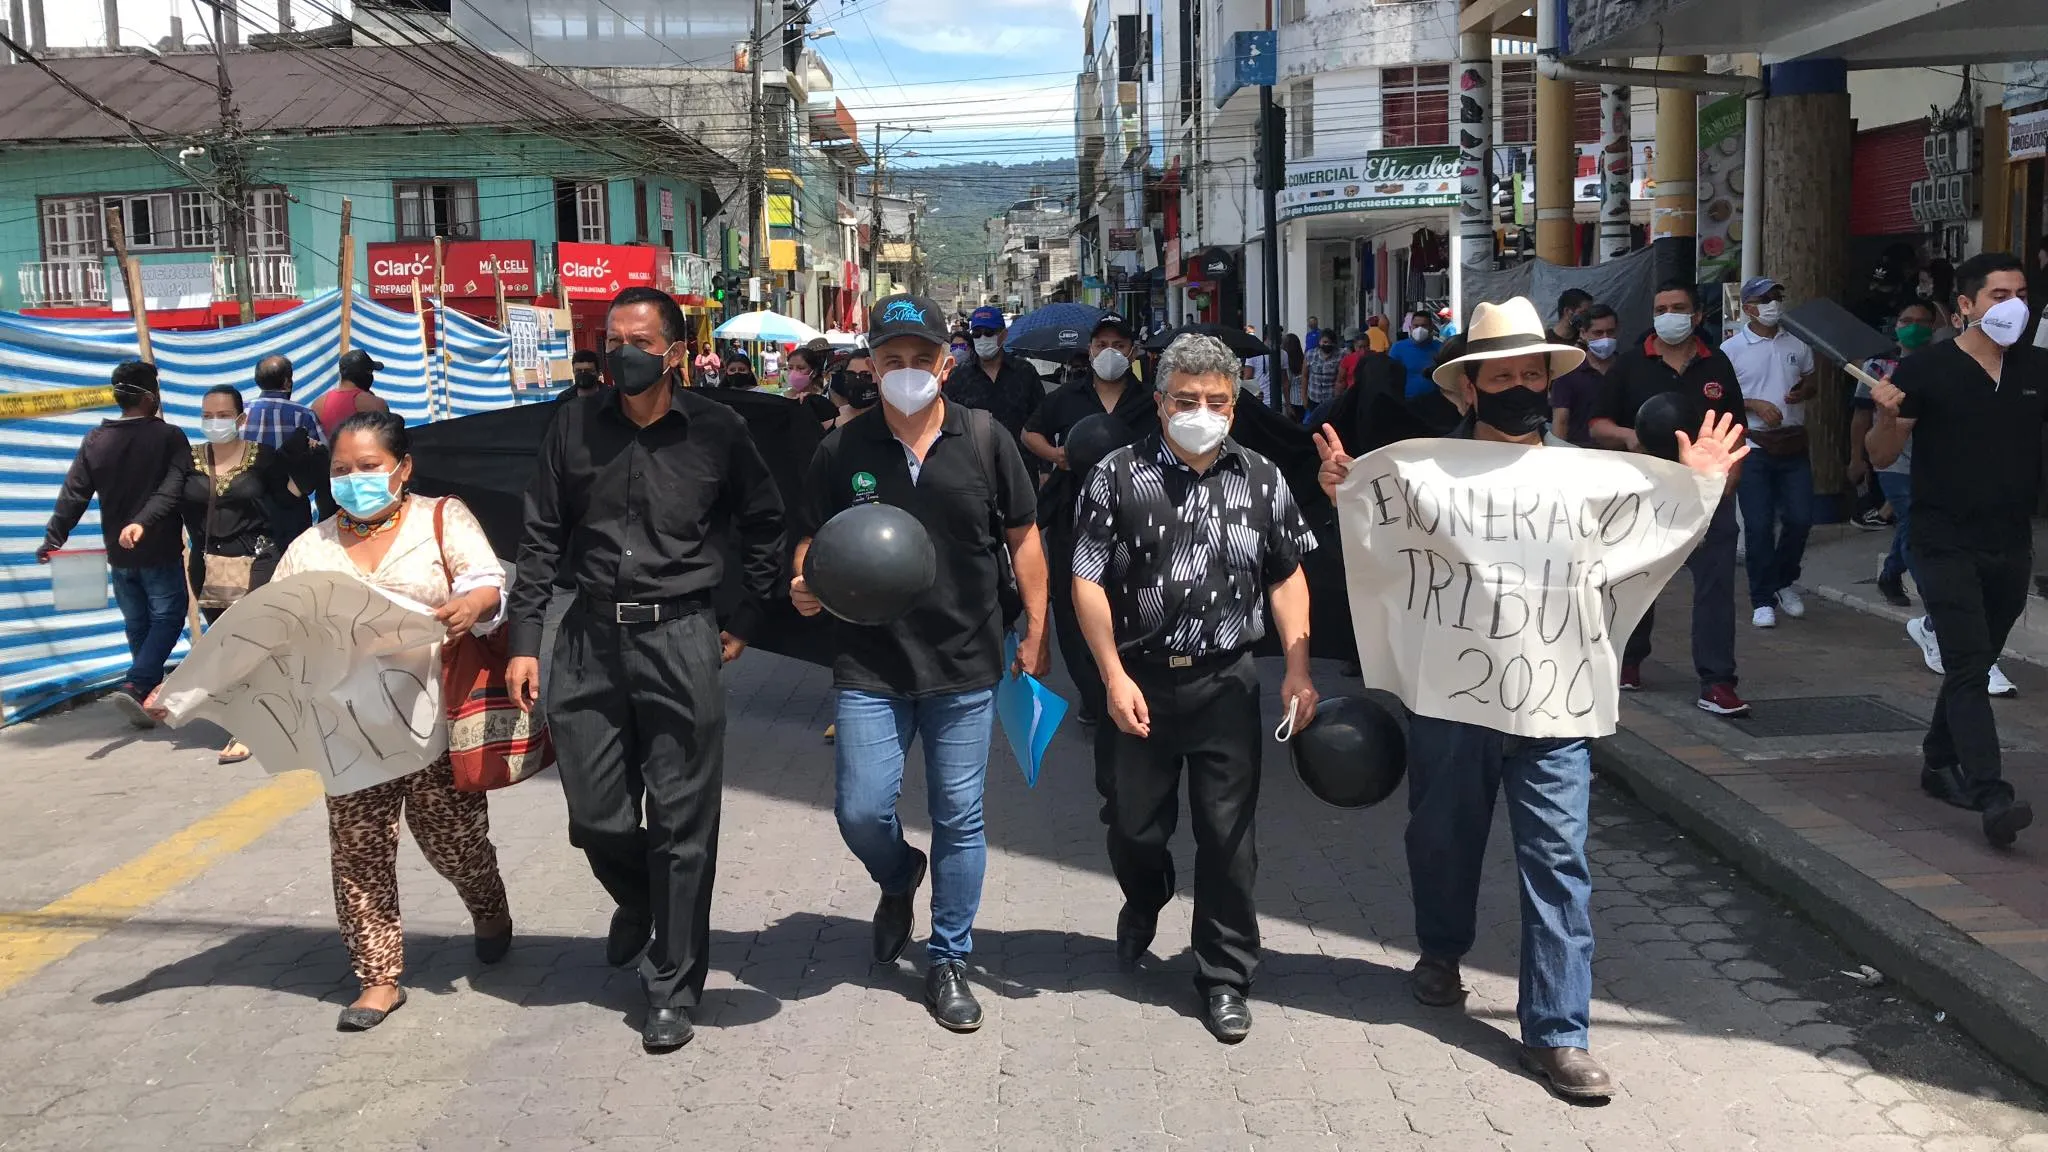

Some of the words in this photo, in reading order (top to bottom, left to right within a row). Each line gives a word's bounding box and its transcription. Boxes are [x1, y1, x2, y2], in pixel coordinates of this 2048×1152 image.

[1288, 167, 1359, 187] COMERCIAL
[1364, 155, 1461, 182] Elizabet
[1303, 203, 1333, 213] buscas
[1334, 201, 1344, 210] lo
[1347, 197, 1415, 208] encuentras
[374, 257, 427, 276] Claro
[503, 259, 529, 270] CELL
[562, 259, 608, 278] Claro
[375, 284, 412, 294] PREPAGO
[32, 391, 67, 413] PELIGRO
[72, 388, 105, 408] PELIGRO
